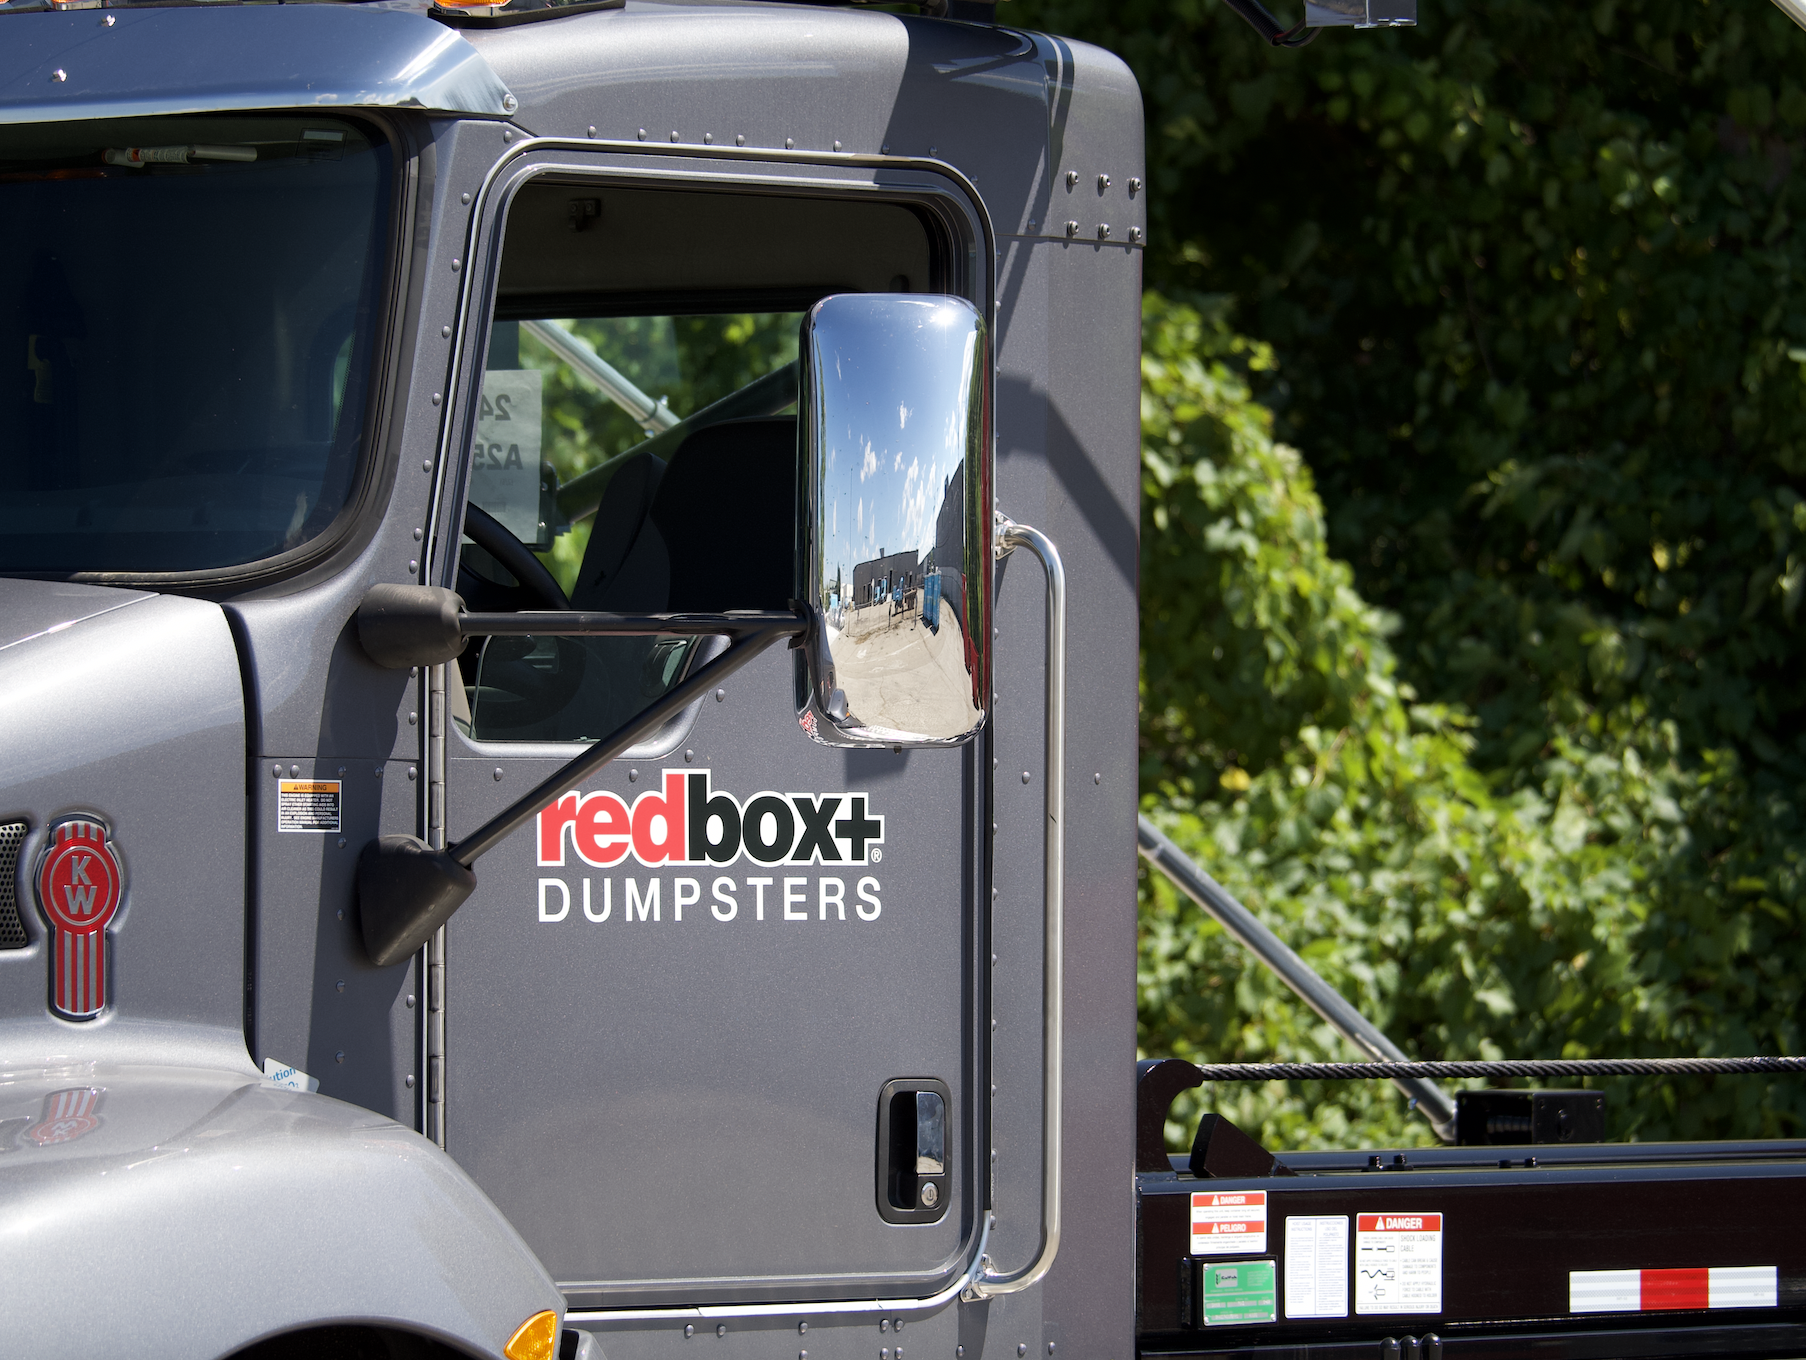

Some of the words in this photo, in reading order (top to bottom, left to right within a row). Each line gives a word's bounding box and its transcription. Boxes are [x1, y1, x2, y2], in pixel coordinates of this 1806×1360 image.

[538, 875, 882, 923] DUMPSTERS
[1220, 1195, 1246, 1205] DANGER
[1220, 1223, 1246, 1233] PELIGRO
[1385, 1217, 1423, 1229] DANGER
[1400, 1234, 1415, 1242] SHOCK
[1417, 1234, 1436, 1242] LOADING
